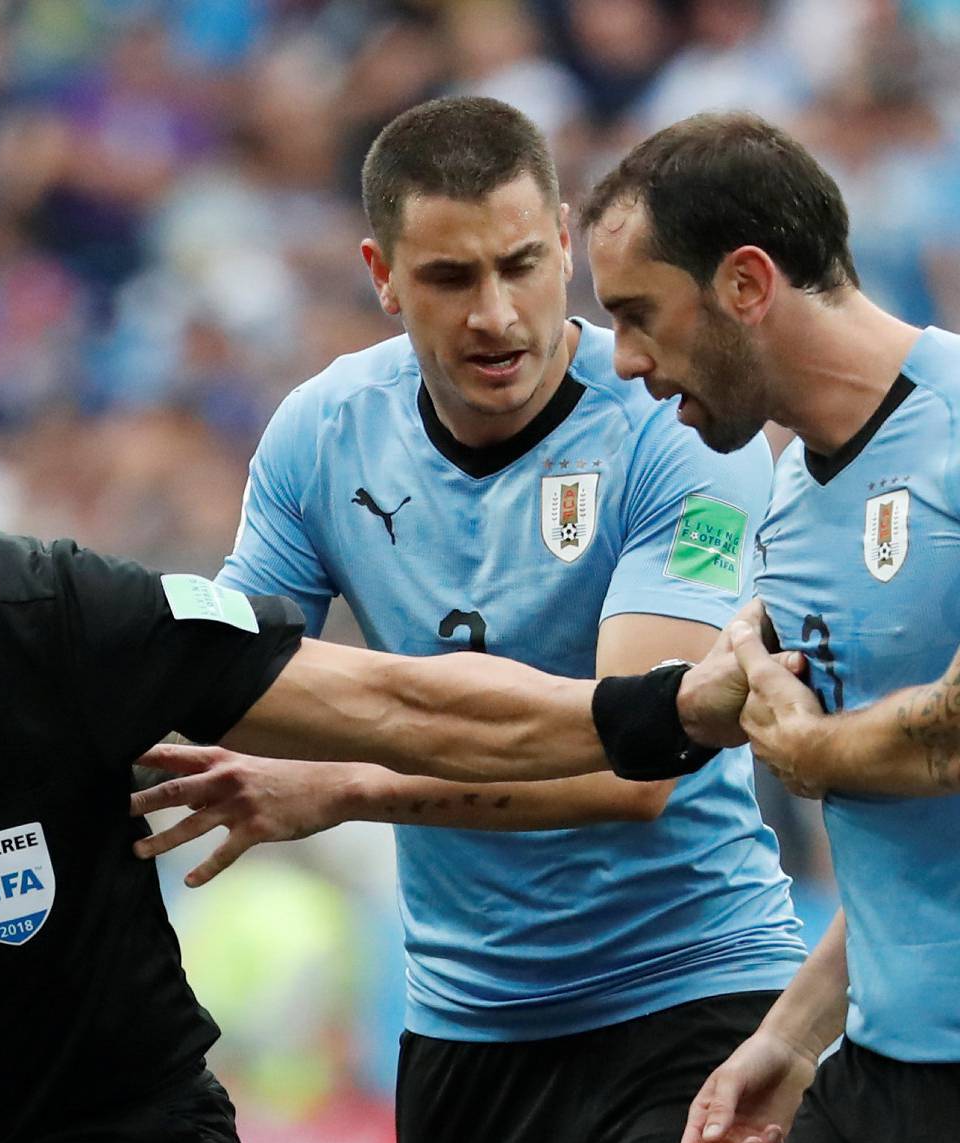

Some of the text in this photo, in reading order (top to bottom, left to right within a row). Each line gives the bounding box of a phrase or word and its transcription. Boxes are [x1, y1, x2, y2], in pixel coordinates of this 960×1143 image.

[684, 520, 739, 546] LIVING
[713, 555, 735, 573] FIFA
[0, 920, 34, 938] 2018
